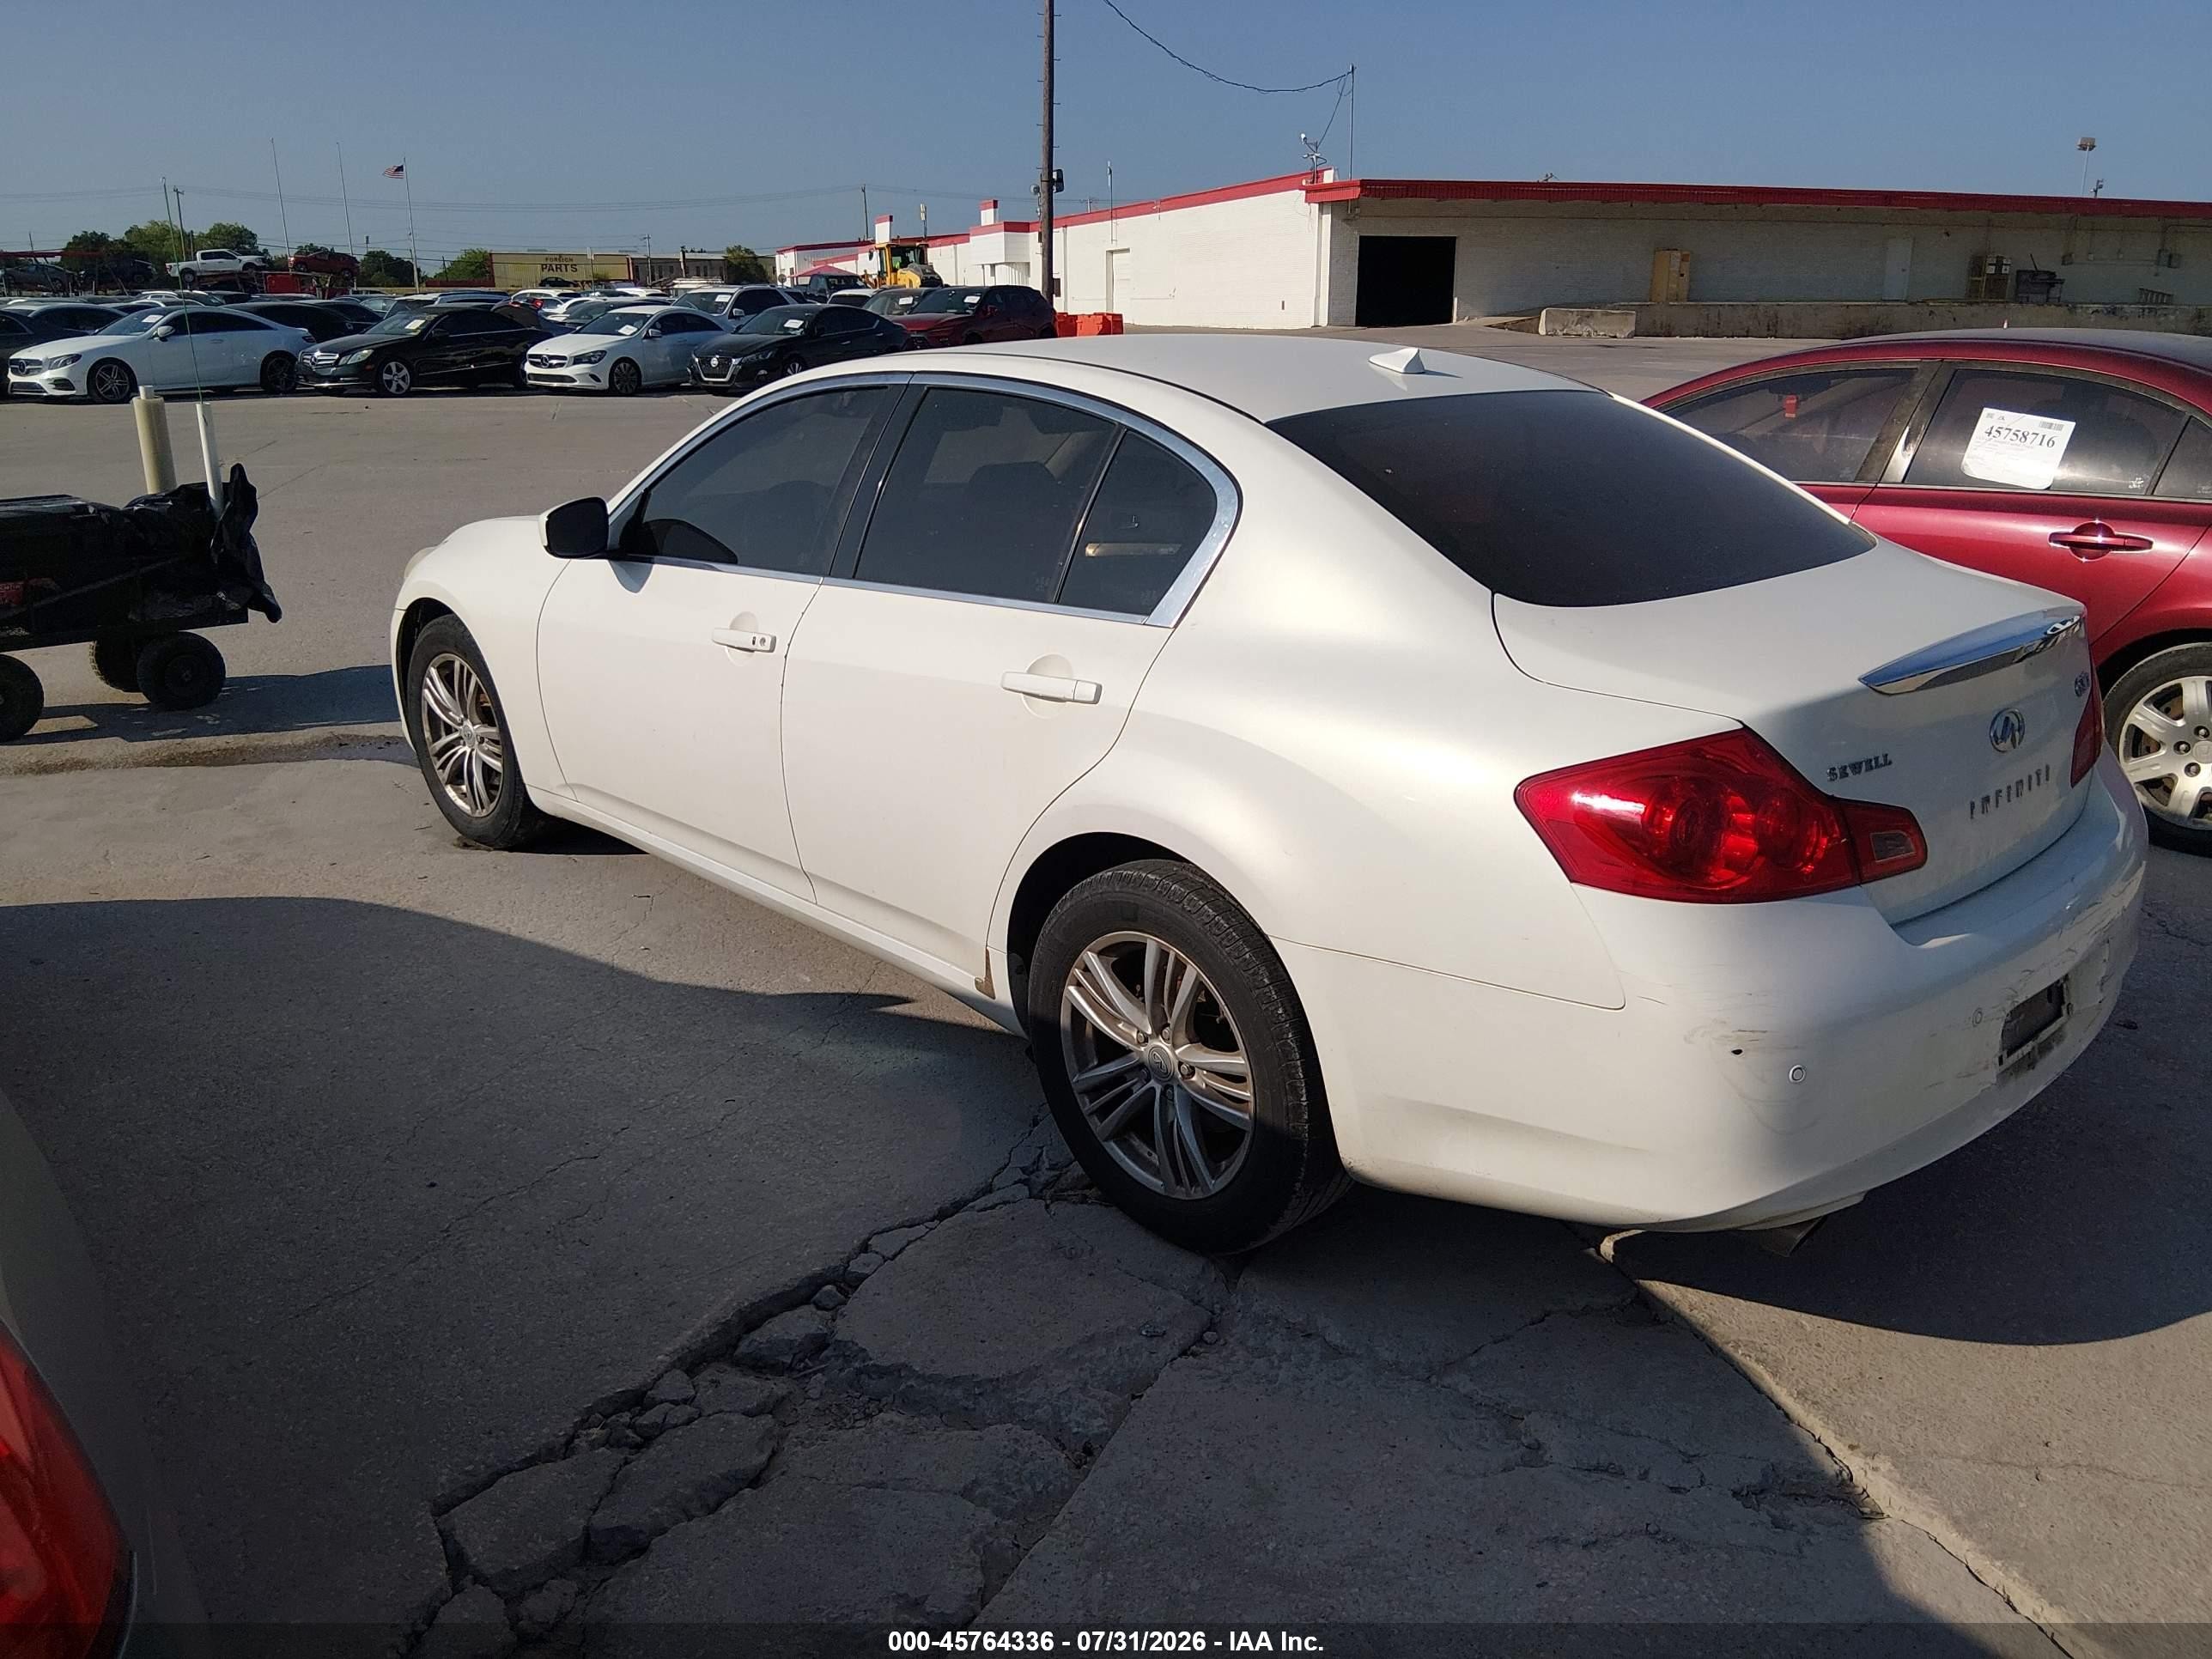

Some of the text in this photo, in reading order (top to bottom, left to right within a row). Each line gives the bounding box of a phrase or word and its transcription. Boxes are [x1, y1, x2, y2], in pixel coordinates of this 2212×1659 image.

[541, 264, 578, 272] PARTS
[1984, 425, 2060, 448] 45758716
[1826, 753, 1893, 782] SEWELL
[1970, 763, 2051, 819] INFINITI
